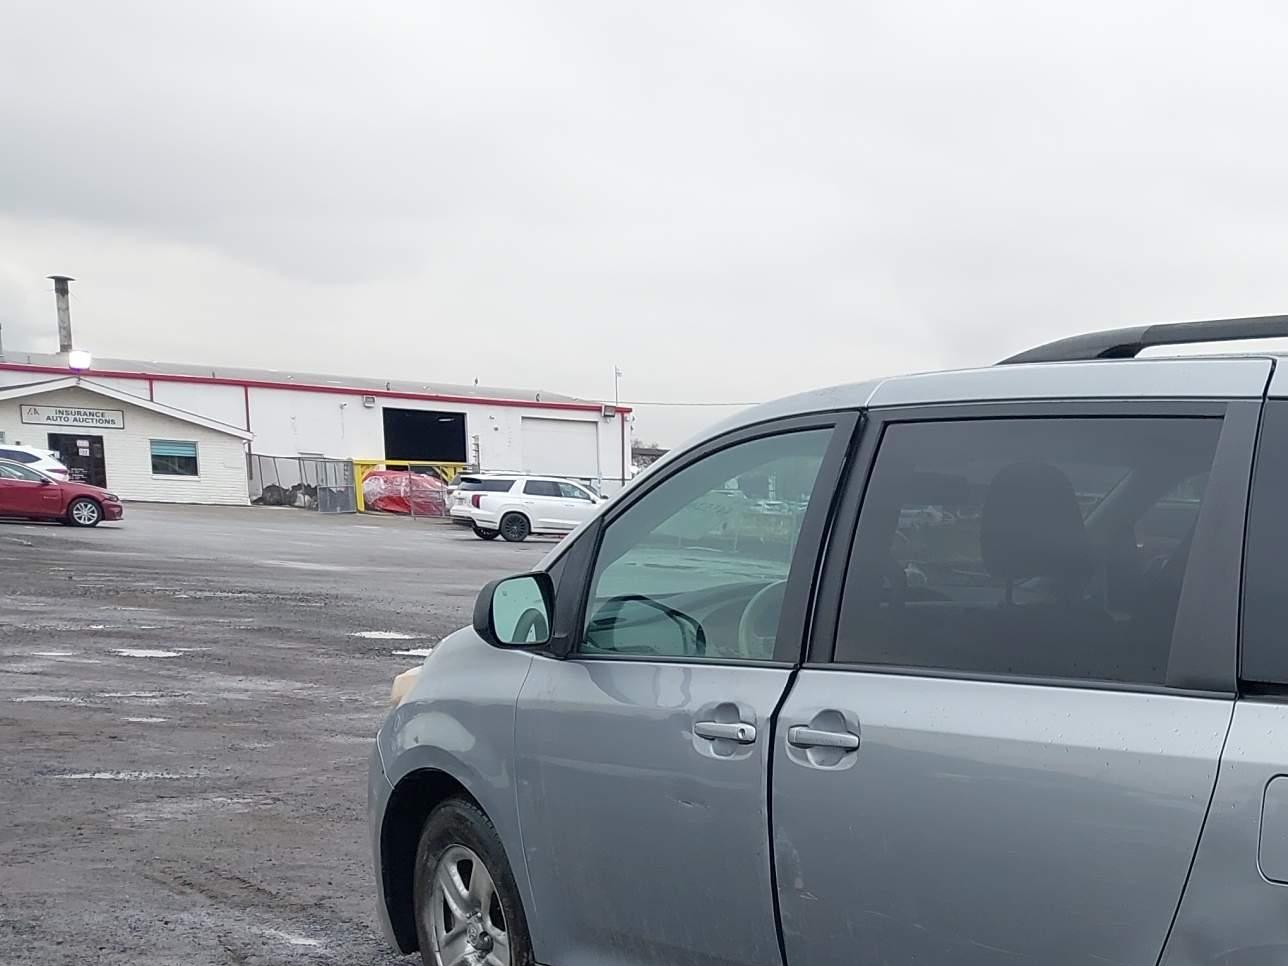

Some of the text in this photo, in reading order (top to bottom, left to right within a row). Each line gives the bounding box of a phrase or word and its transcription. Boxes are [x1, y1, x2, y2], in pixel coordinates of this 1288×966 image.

[55, 409, 105, 418] INSURANCE
[46, 415, 117, 425] AUTO AUCTIONS
